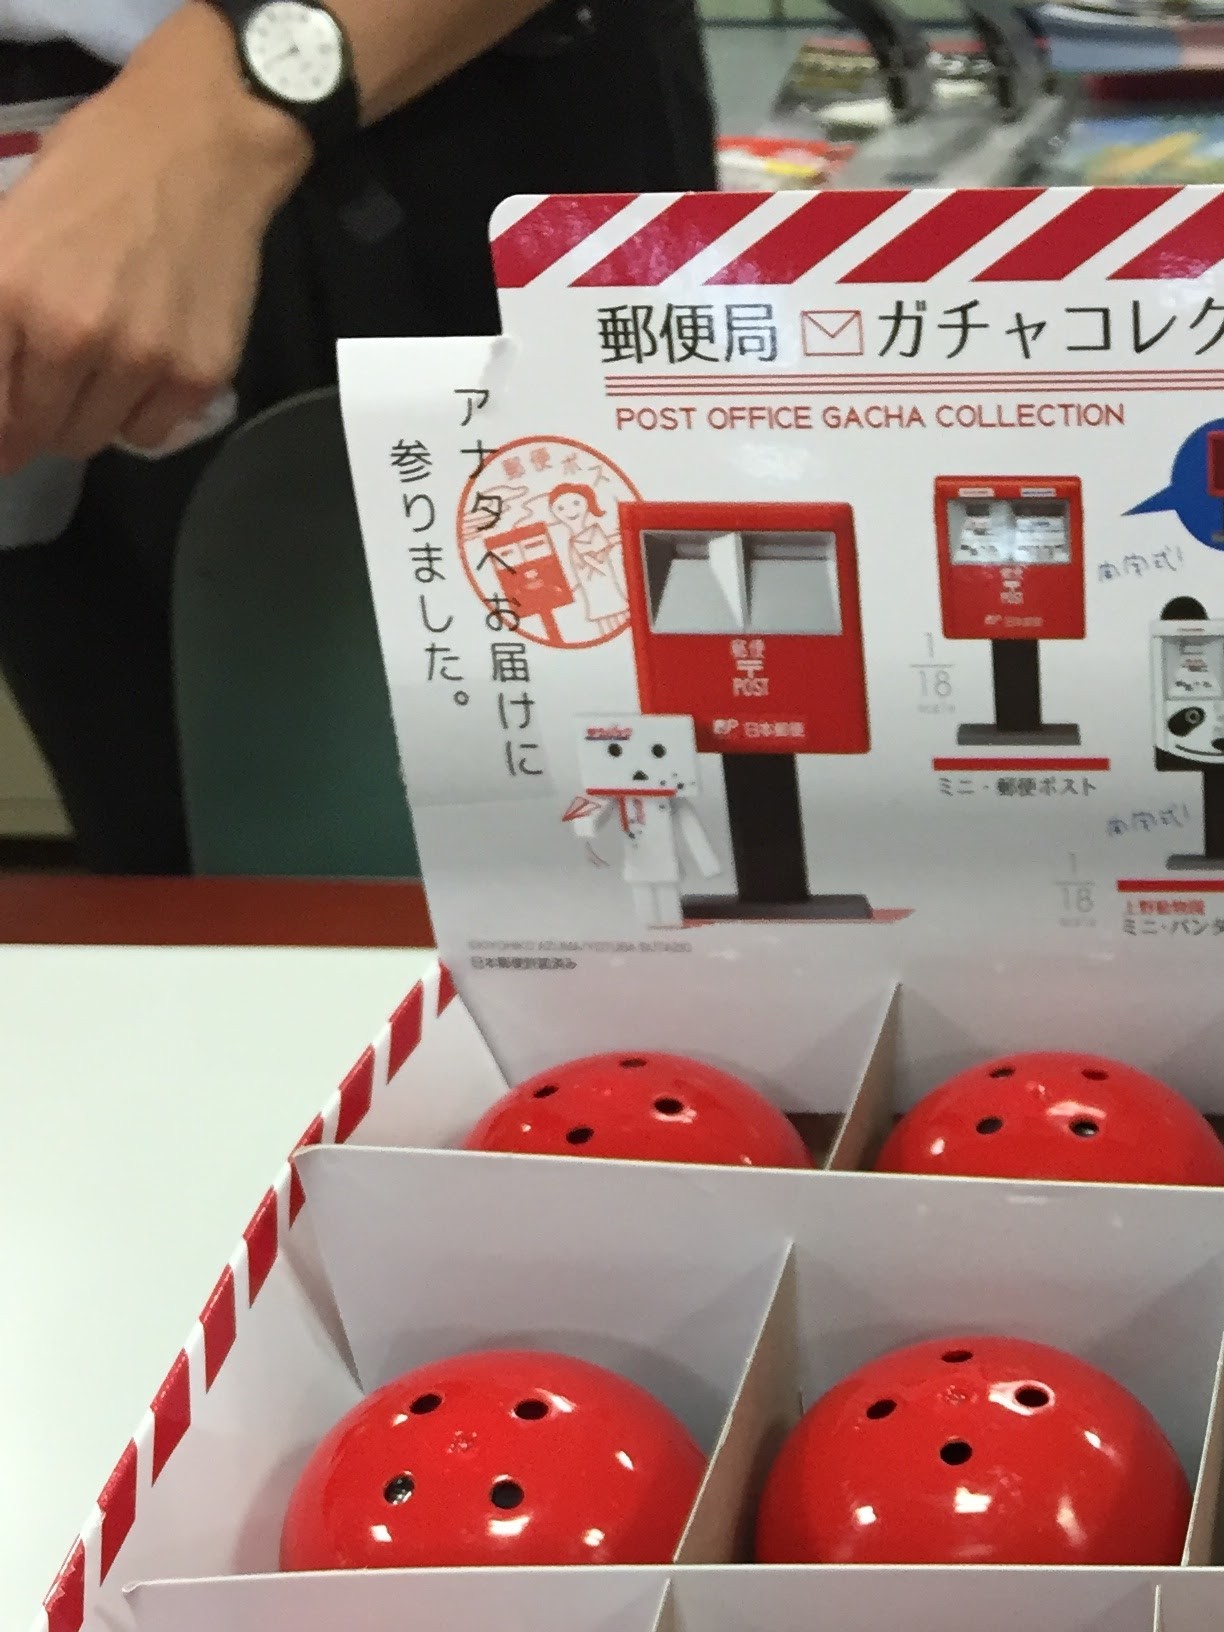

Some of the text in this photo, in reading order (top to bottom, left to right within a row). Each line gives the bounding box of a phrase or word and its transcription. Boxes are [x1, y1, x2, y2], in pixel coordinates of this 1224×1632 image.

[597, 302, 778, 364] 郵便局
[616, 403, 1125, 431] POST OFFICE GACHA COLLECTION
[389, 437, 470, 708] 参りました。
[453, 388, 544, 777] アナタへお届けに
